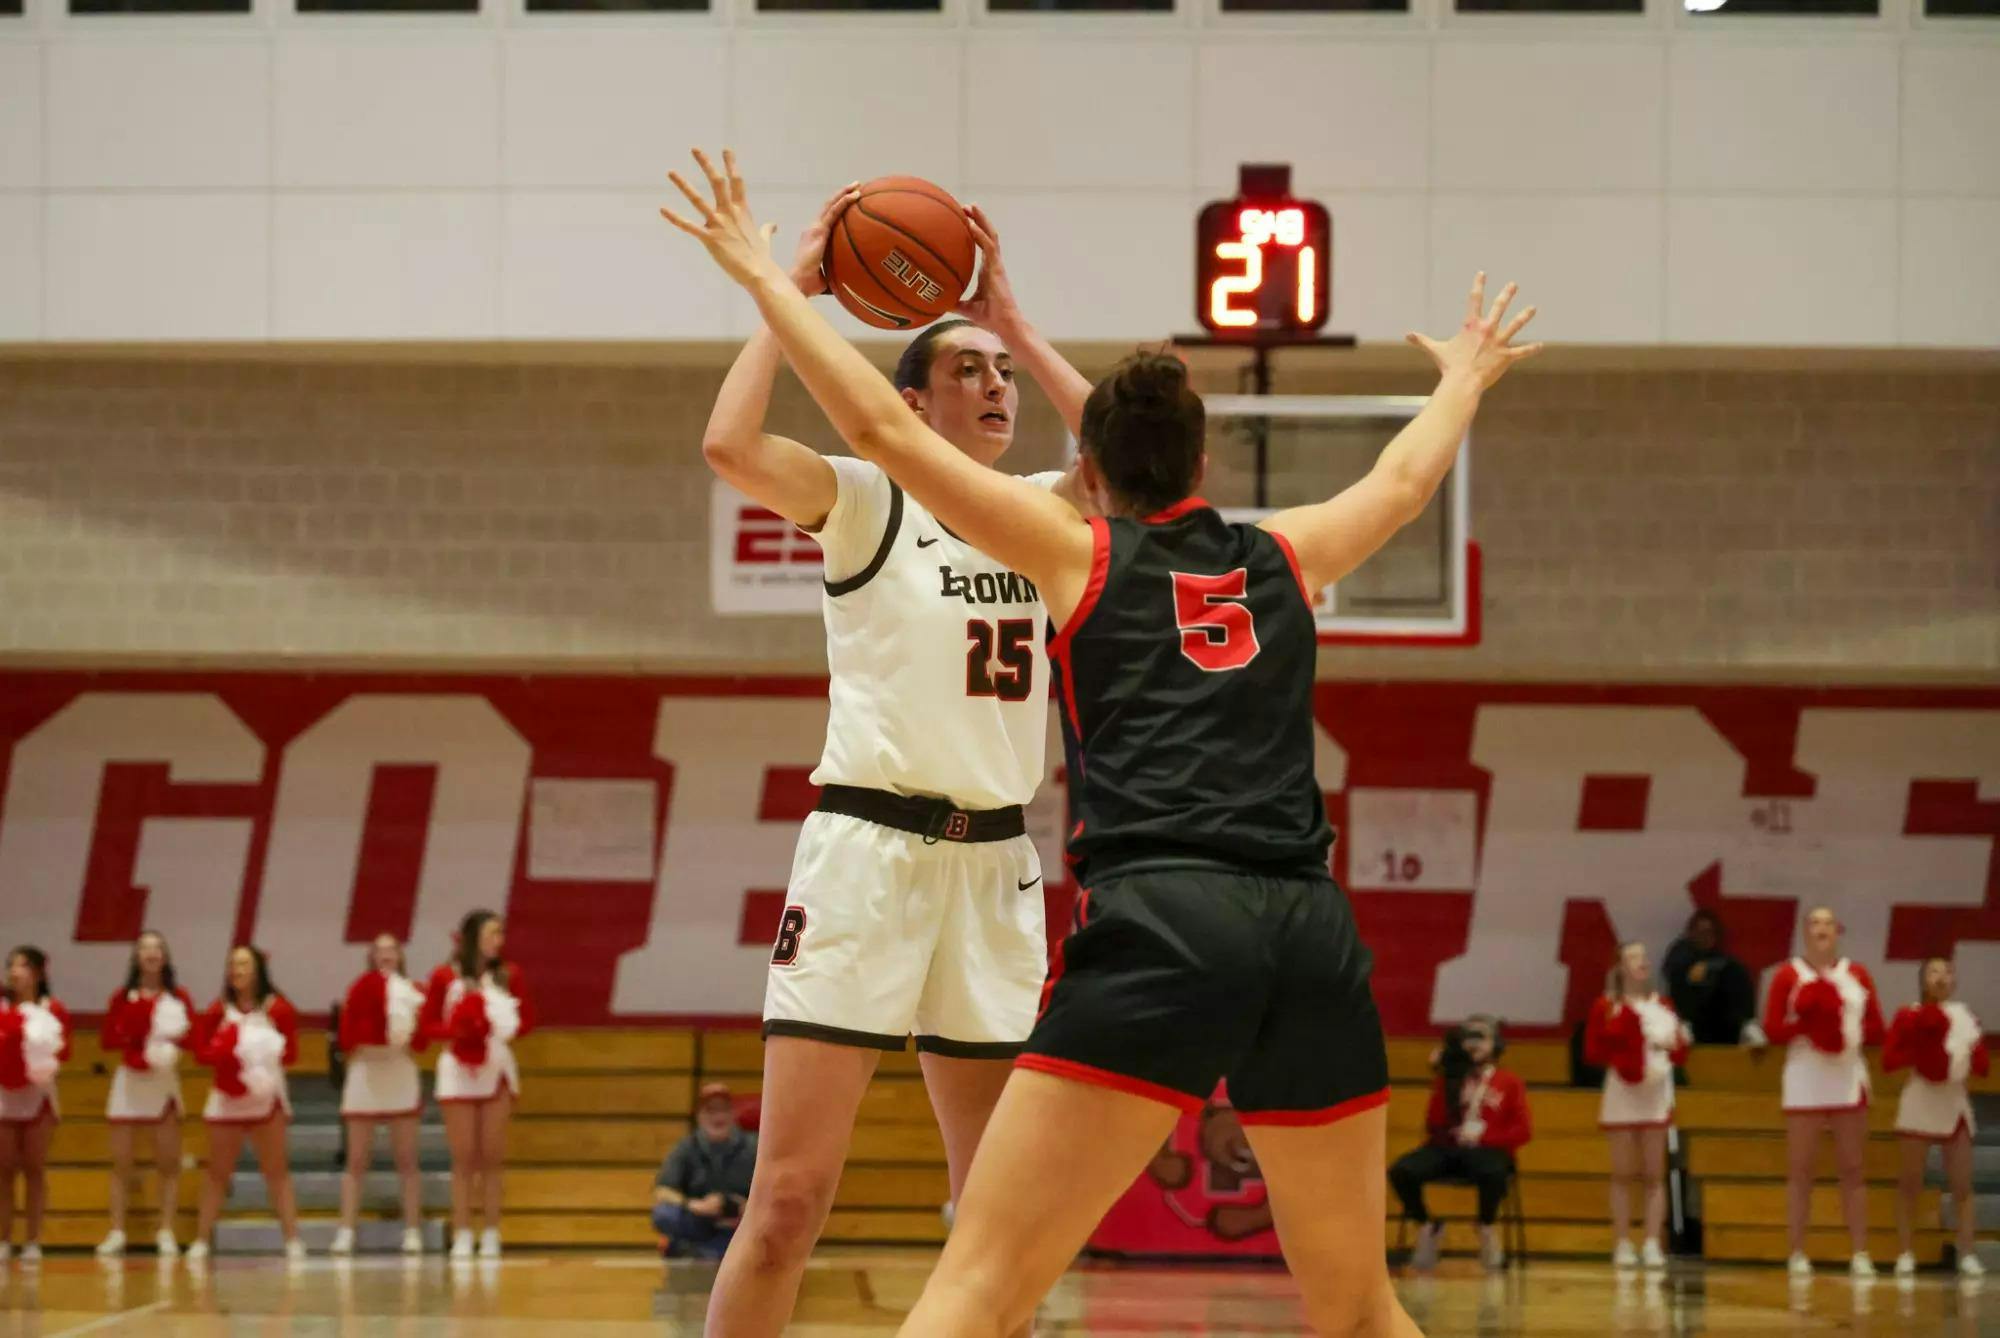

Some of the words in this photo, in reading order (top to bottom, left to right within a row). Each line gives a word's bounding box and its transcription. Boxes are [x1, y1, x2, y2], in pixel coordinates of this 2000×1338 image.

[880, 249, 944, 303] ELITE
[1211, 242, 1315, 326] 21
[966, 618, 1034, 702] 25
[1169, 567, 1261, 672] 5
[0, 692, 533, 1014] GO
[946, 812, 969, 839] B
[769, 905, 807, 967] B
